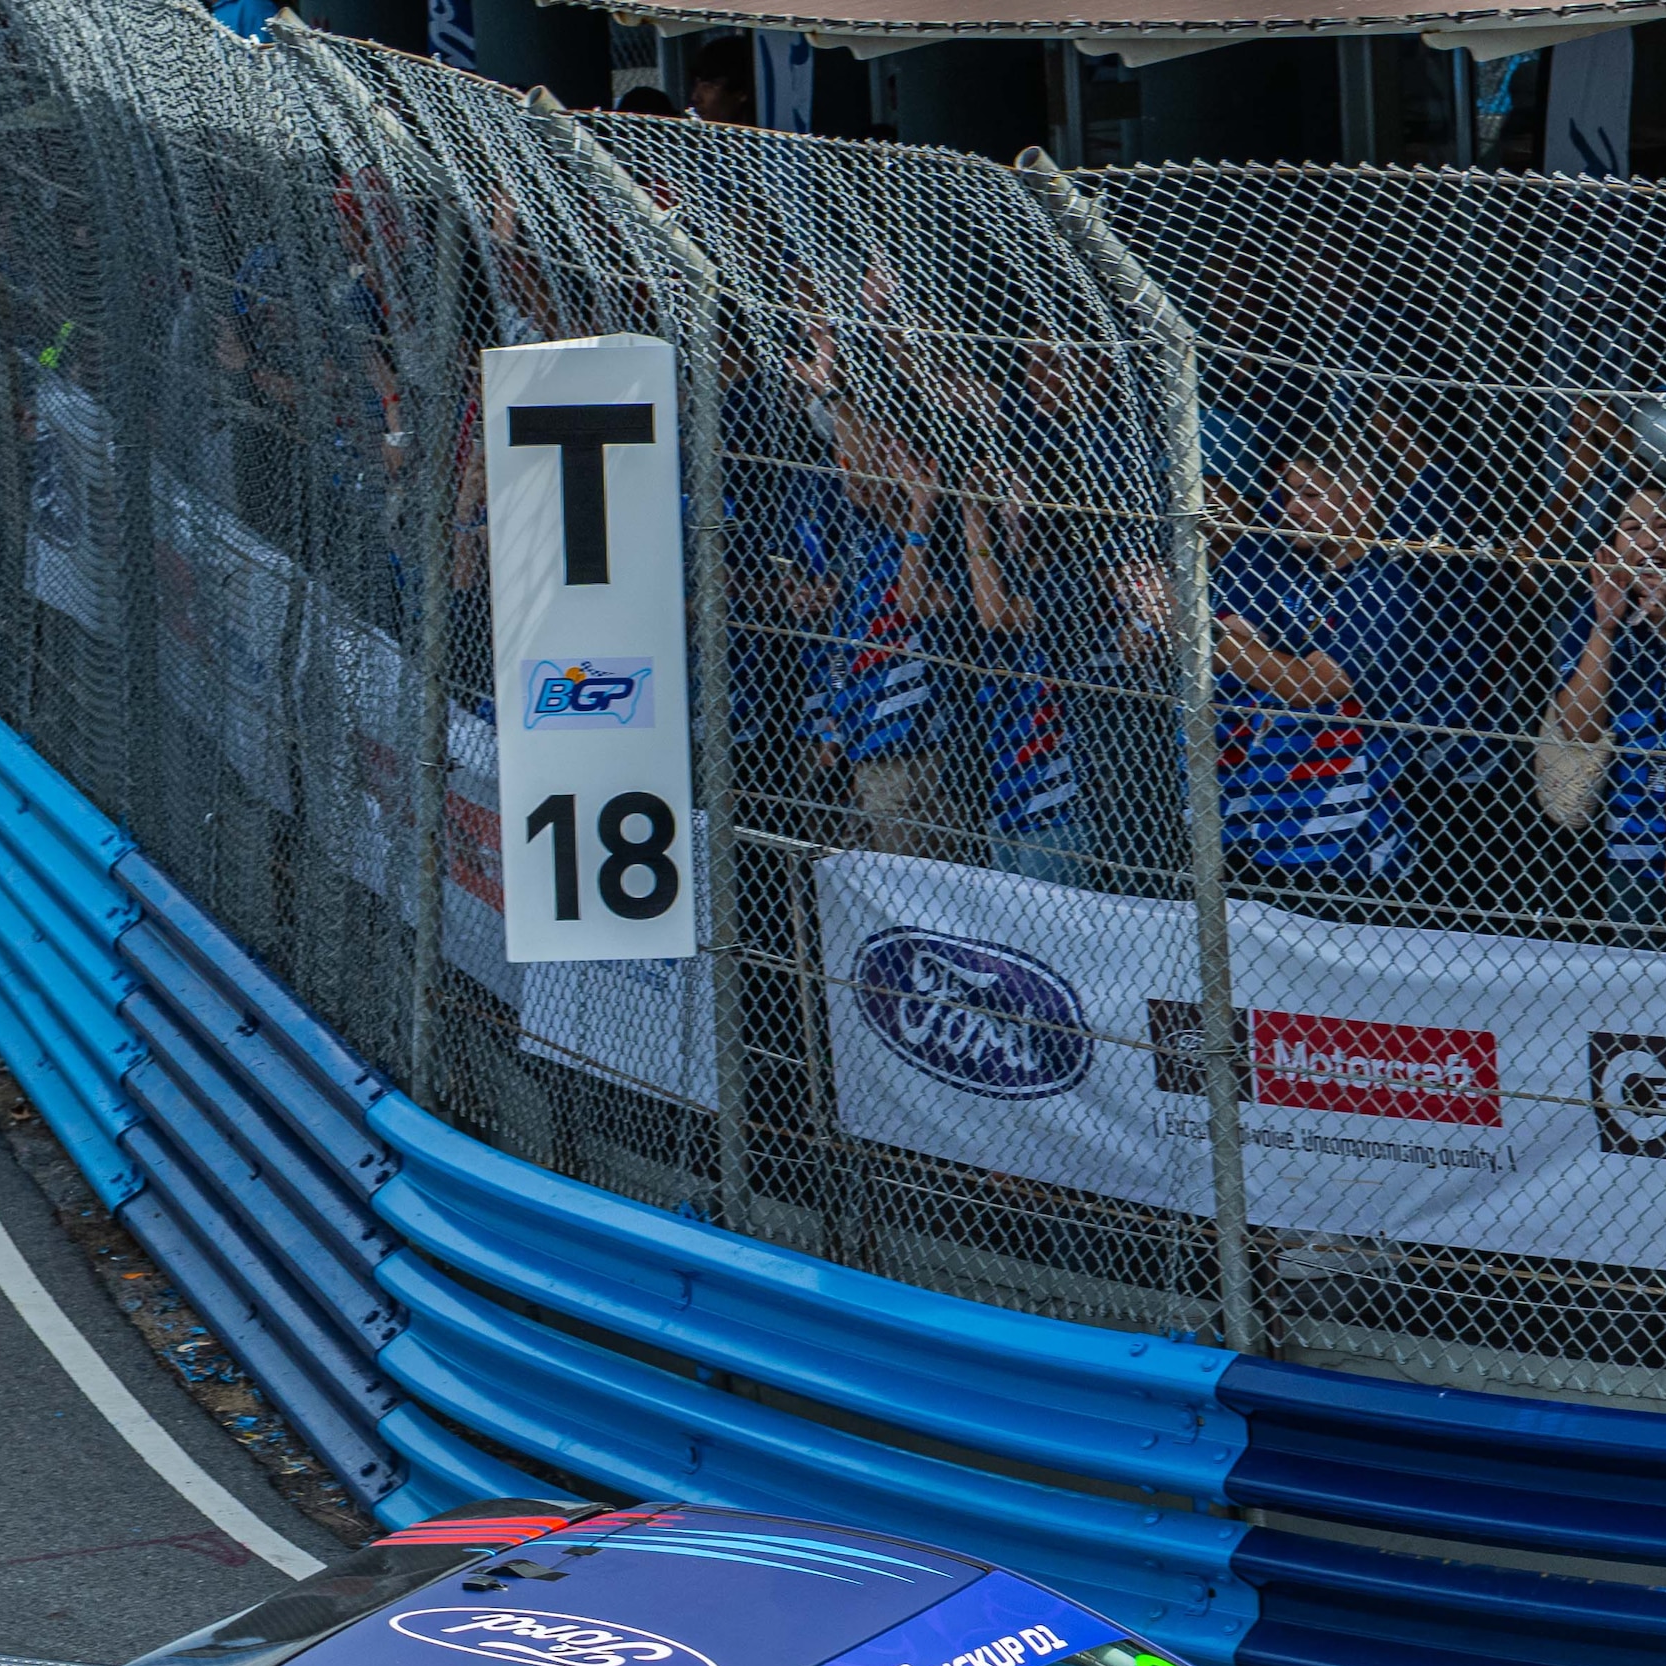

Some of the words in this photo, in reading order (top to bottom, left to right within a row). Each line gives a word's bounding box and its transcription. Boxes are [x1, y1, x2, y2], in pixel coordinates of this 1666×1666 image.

[507, 404, 656, 585] T
[534, 677, 635, 714] BGP
[524, 791, 680, 921] 18
[1274, 1039, 1476, 1099] Motorcraft
[1018, 1624, 1069, 1656] D1
